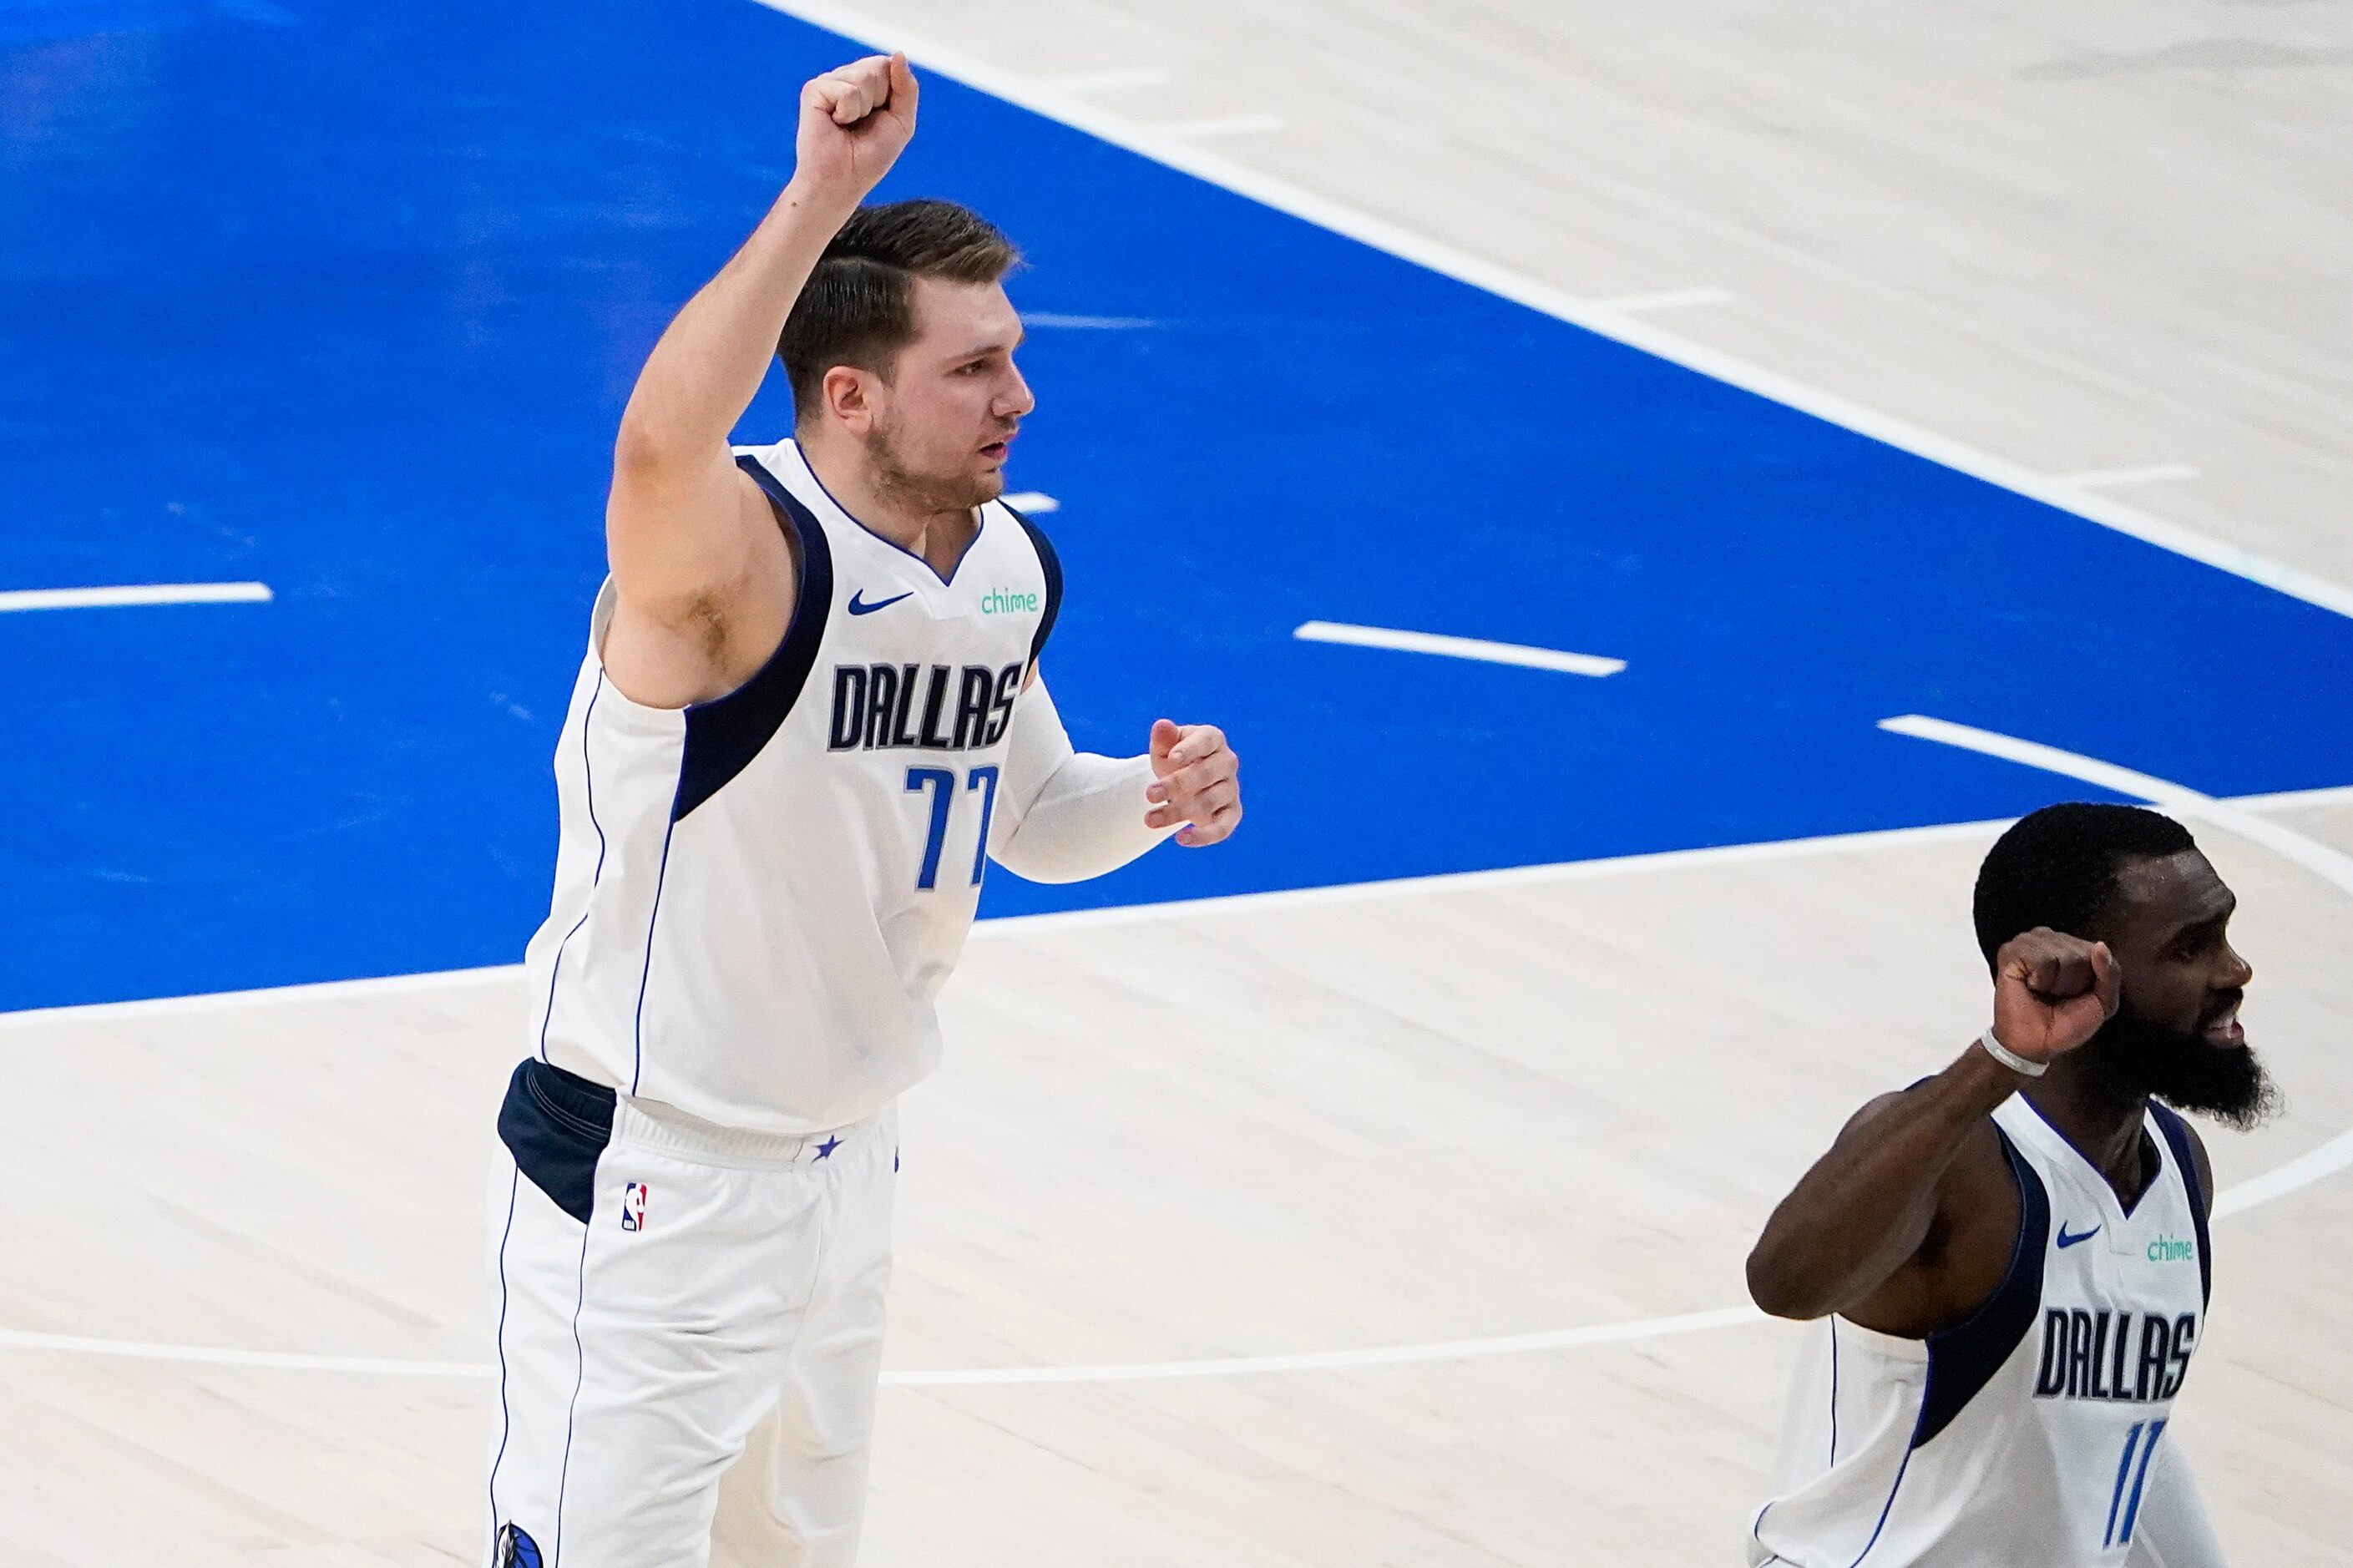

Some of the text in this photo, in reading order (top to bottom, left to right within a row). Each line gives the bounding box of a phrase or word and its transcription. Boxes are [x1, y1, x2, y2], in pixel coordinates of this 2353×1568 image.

[981, 587, 1038, 615] chime
[827, 660, 1025, 751] DALLAS
[903, 763, 999, 893] 77
[2147, 1233, 2194, 1262] chime
[2032, 1306, 2196, 1404] DALLAS
[2103, 1419, 2167, 1550] 11
